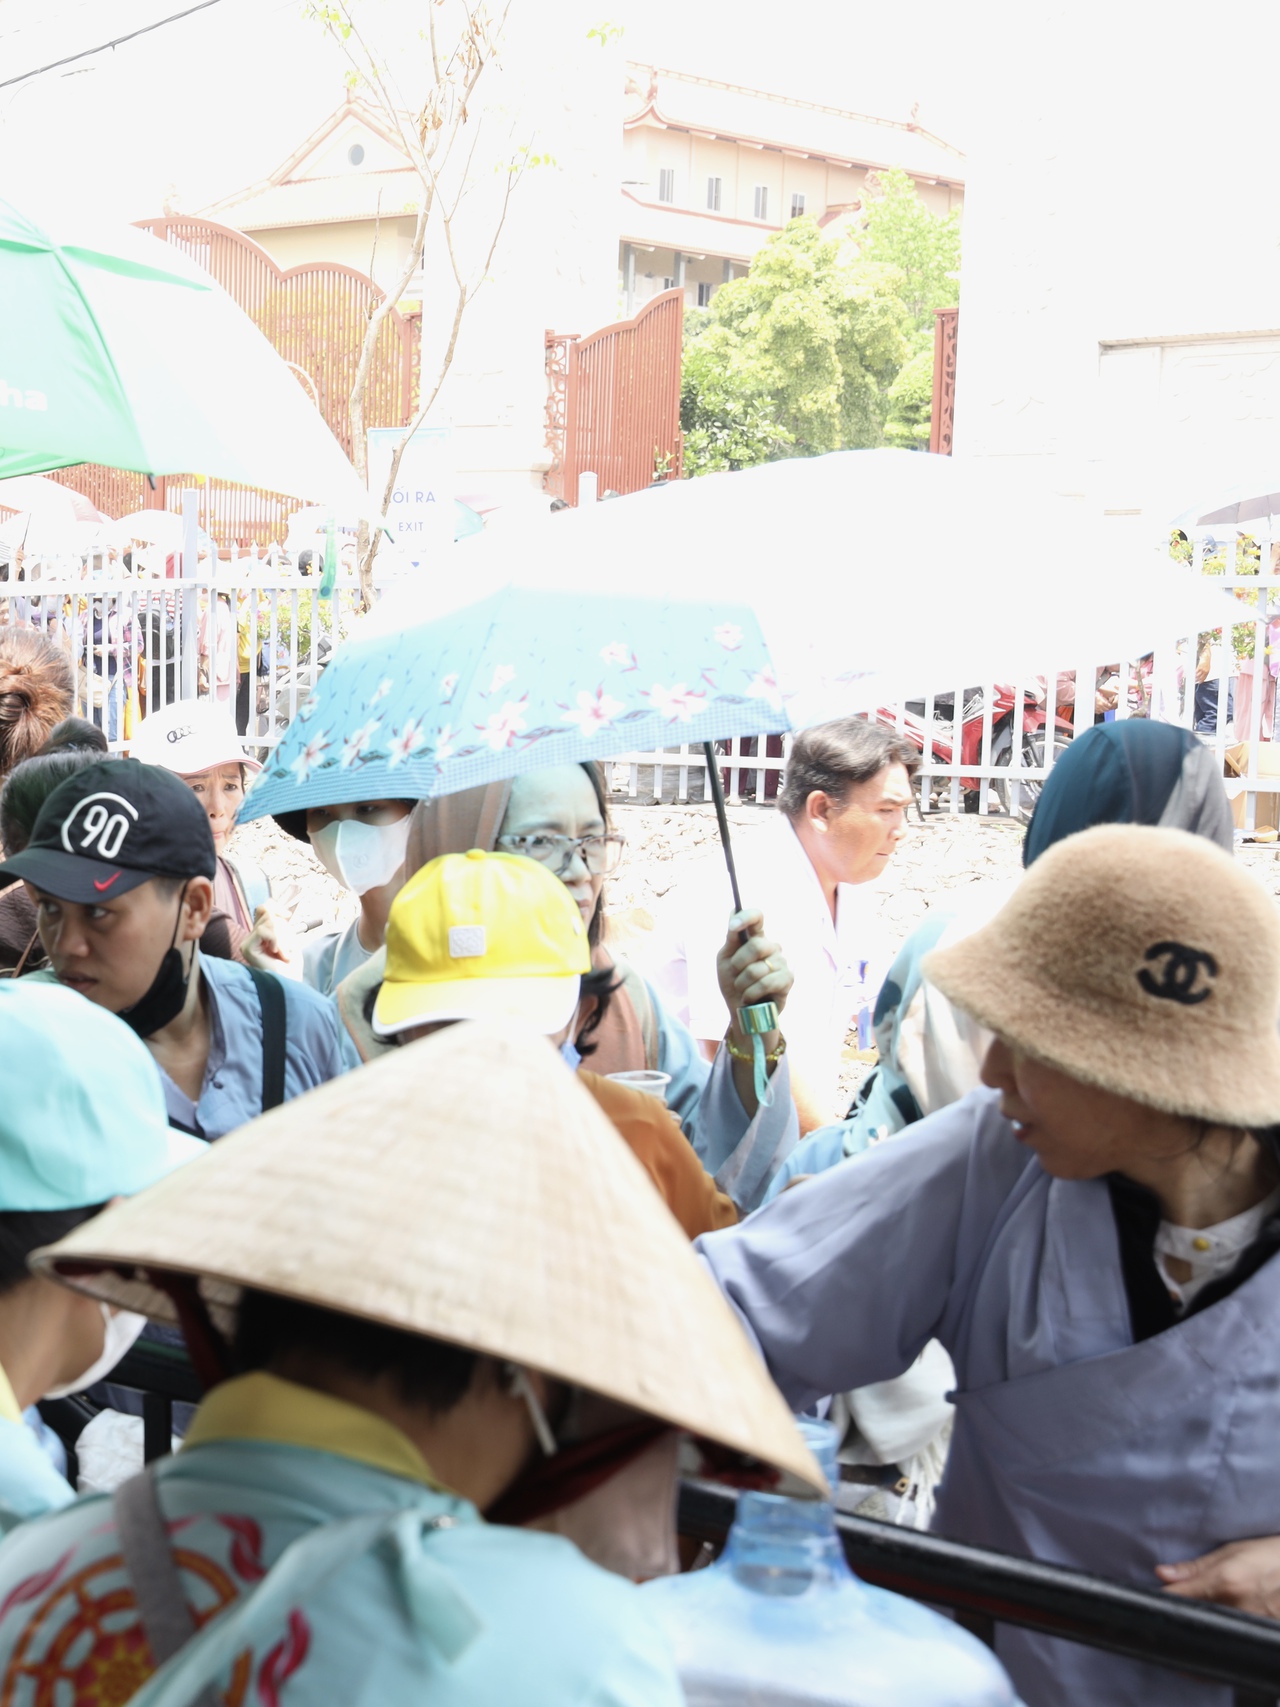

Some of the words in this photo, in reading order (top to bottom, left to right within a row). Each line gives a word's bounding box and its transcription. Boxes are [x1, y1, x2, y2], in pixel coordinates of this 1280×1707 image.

[416, 491, 436, 503] RA
[398, 521, 424, 532] EXIT
[80, 805, 129, 858] 90
